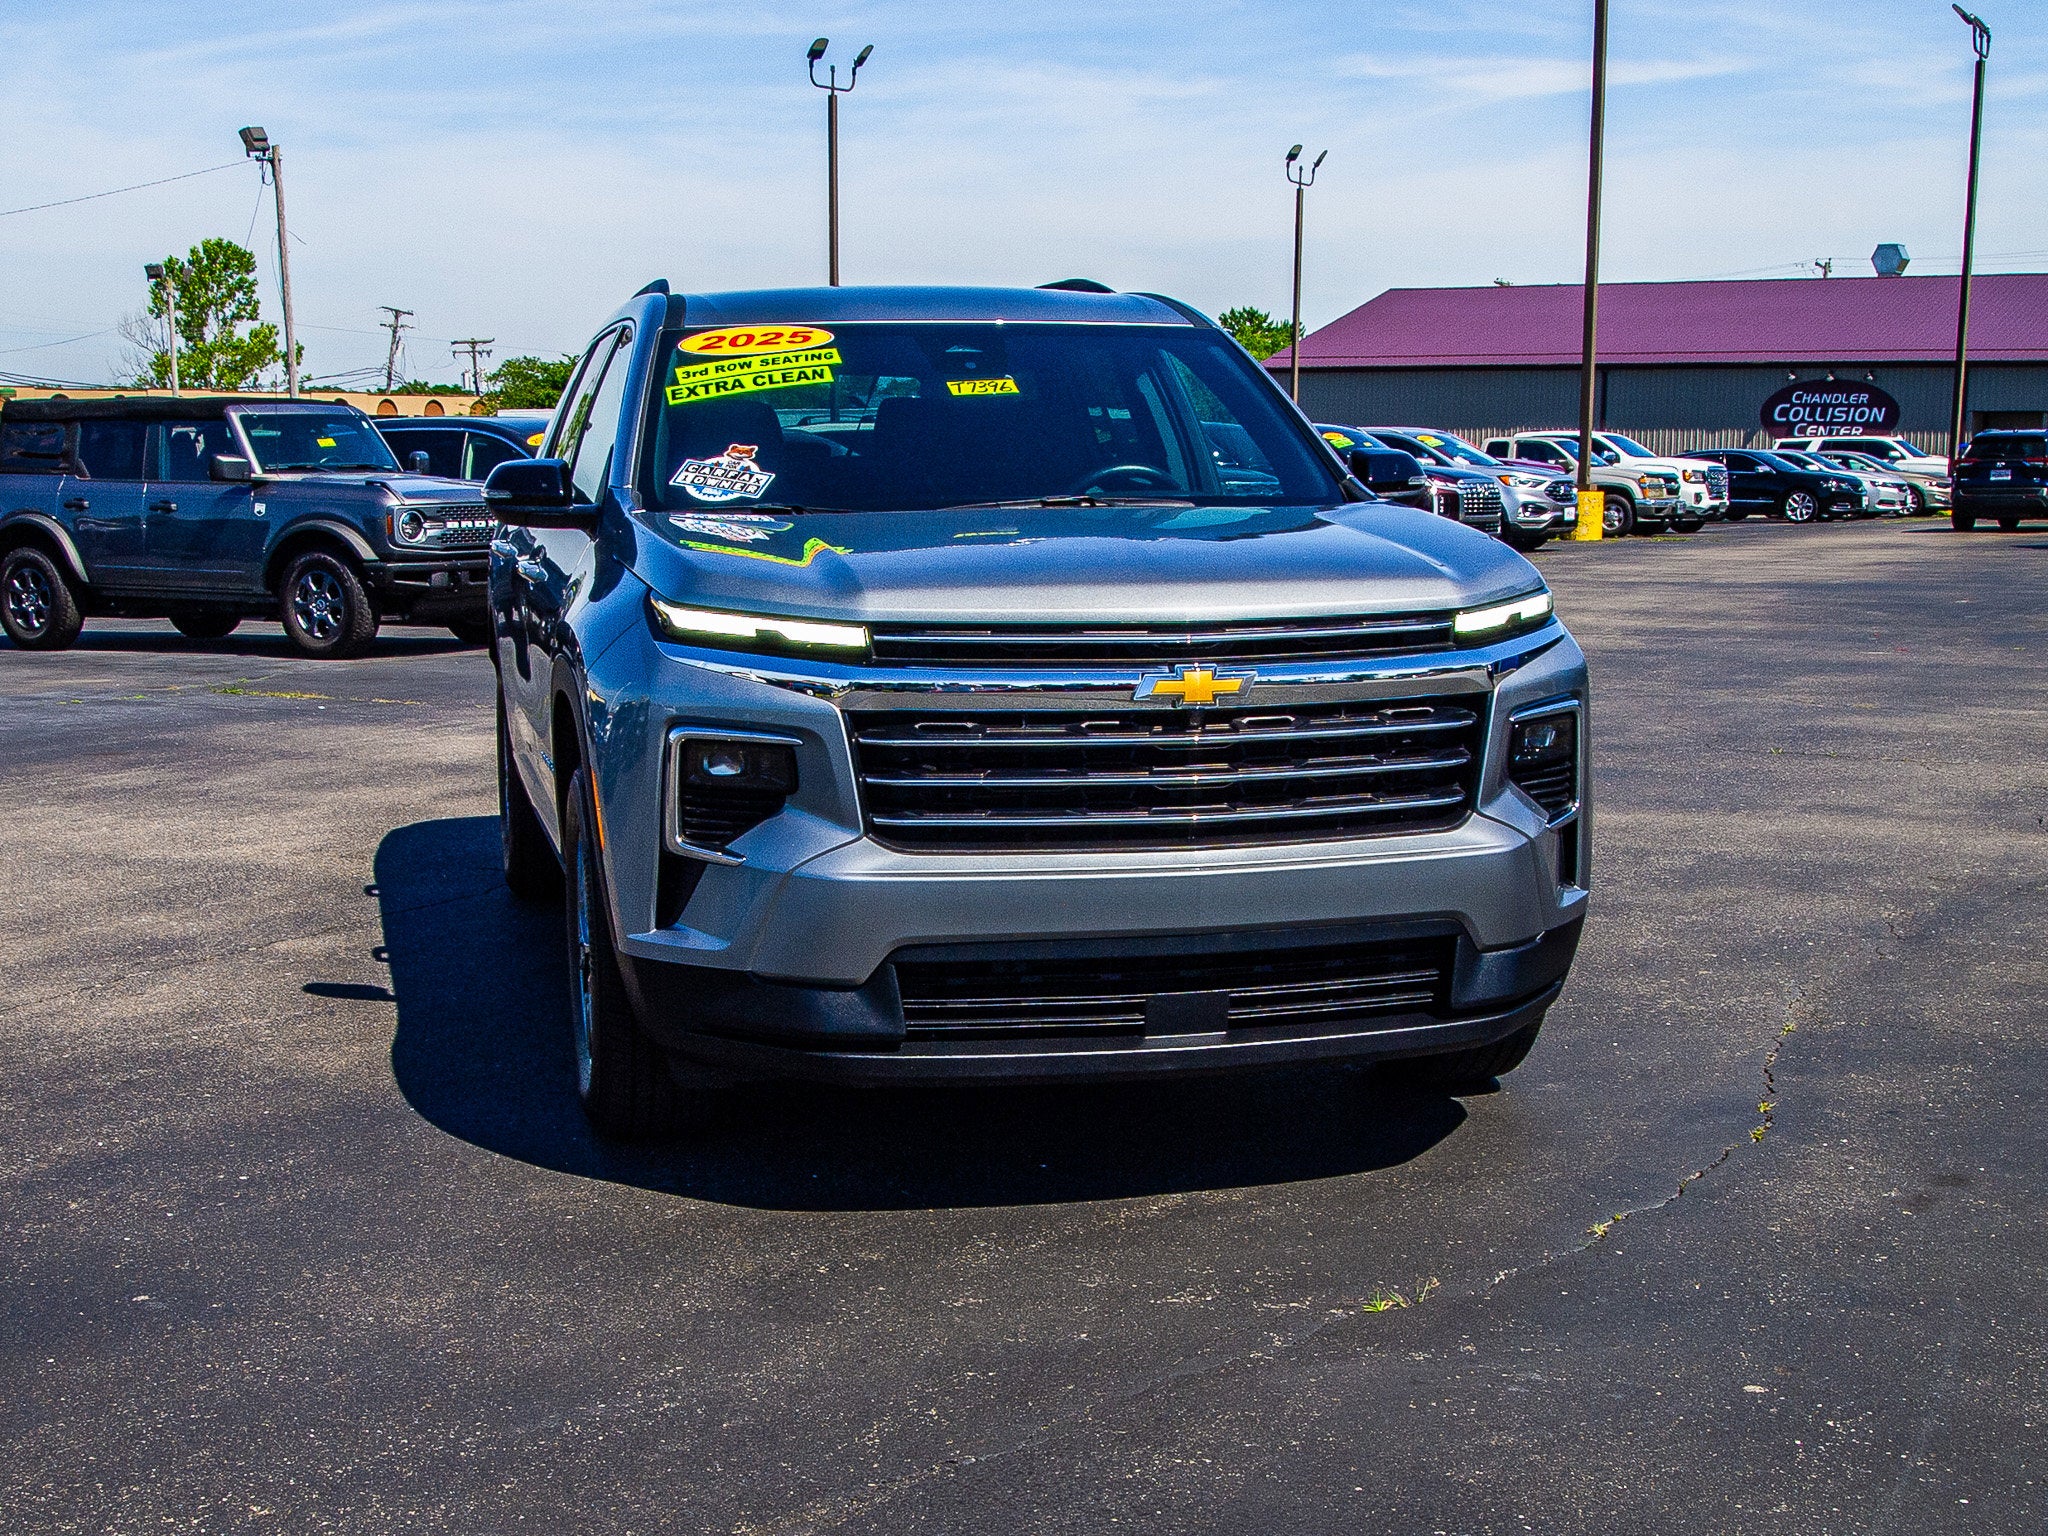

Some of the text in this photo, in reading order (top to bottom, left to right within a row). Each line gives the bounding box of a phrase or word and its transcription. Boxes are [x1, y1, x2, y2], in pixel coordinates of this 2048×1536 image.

[697, 331, 813, 350] 2025
[681, 352, 834, 379] 3rd ROW SEATING
[671, 368, 825, 400] EXTRA CLEAN
[950, 381, 1013, 393] T7396
[1792, 391, 1869, 404] CHANDLER
[1773, 404, 1886, 422] COLLISION
[1794, 423, 1863, 437] CENTER
[685, 464, 762, 484] CARFAX
[691, 475, 760, 494] OWNER
[446, 520, 499, 529] BRON
